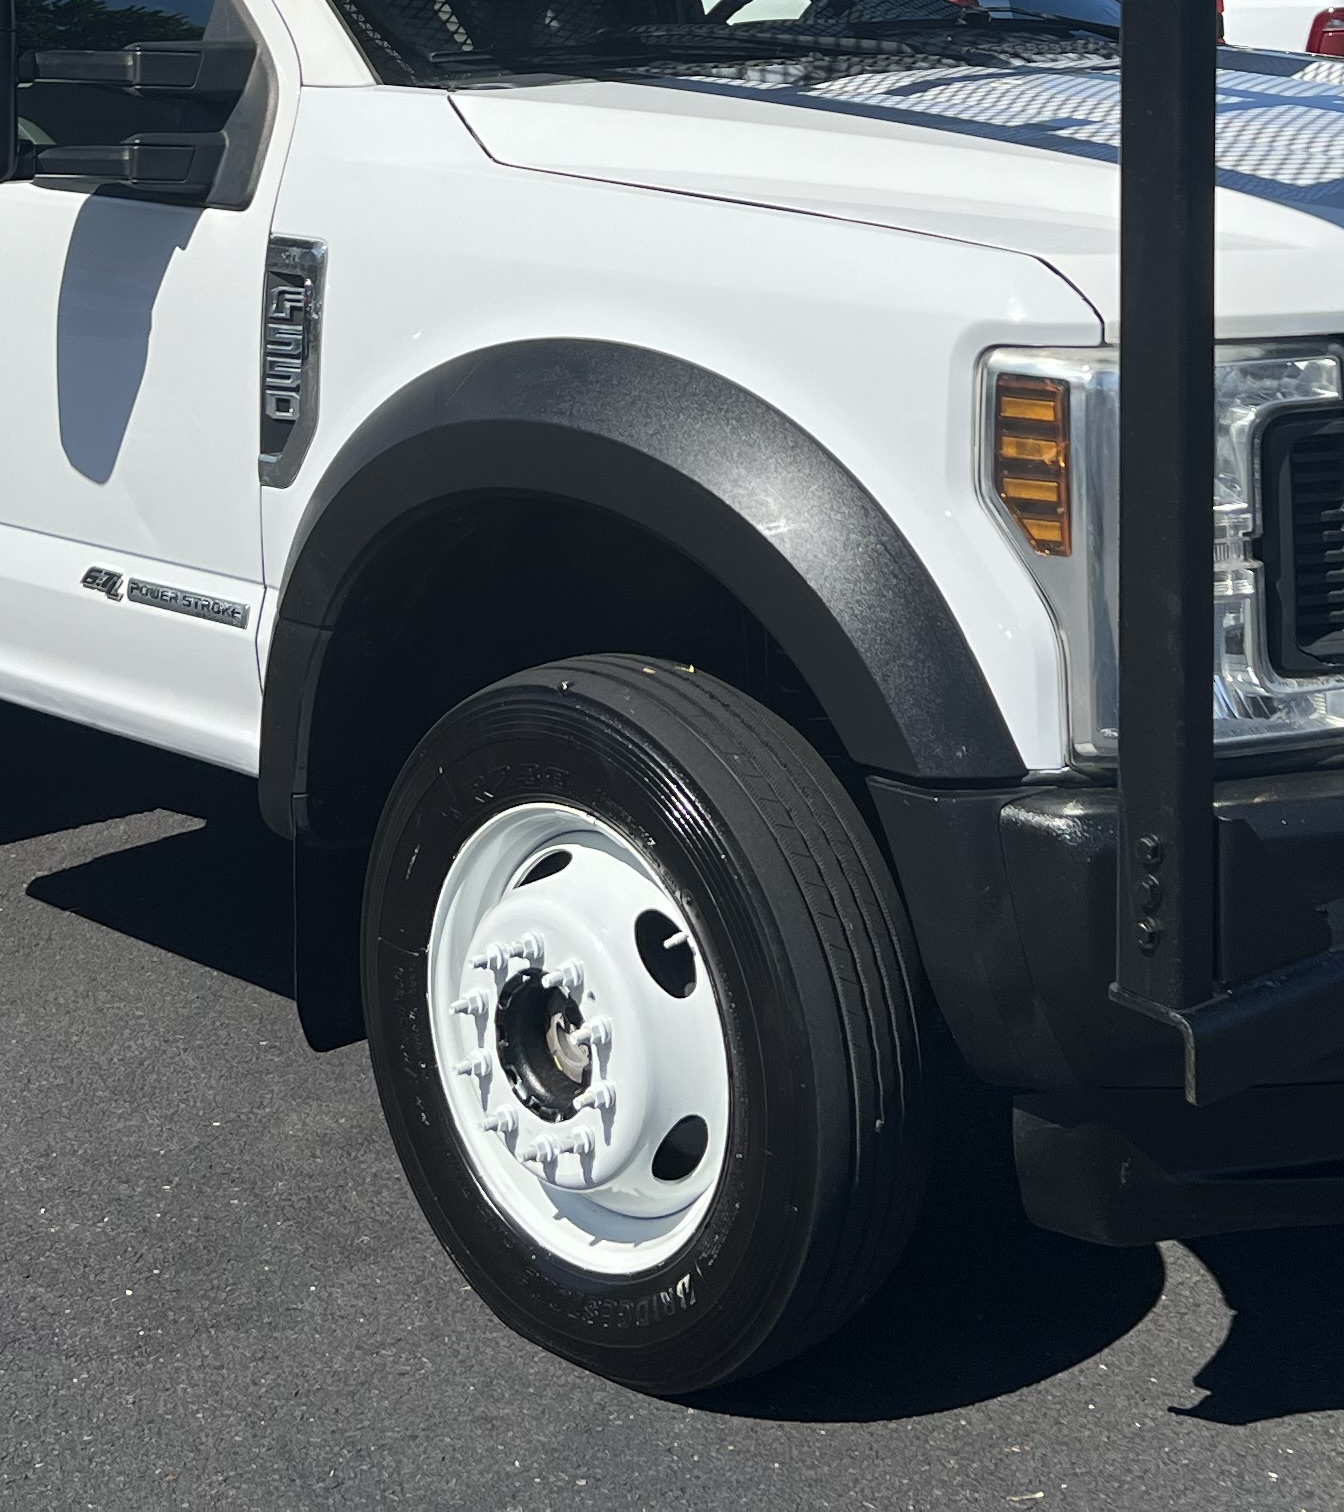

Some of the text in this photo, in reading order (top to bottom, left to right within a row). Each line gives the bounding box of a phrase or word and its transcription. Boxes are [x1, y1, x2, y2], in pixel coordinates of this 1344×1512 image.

[80, 566, 125, 603] 6.7L
[130, 580, 243, 619] POWER STROKE
